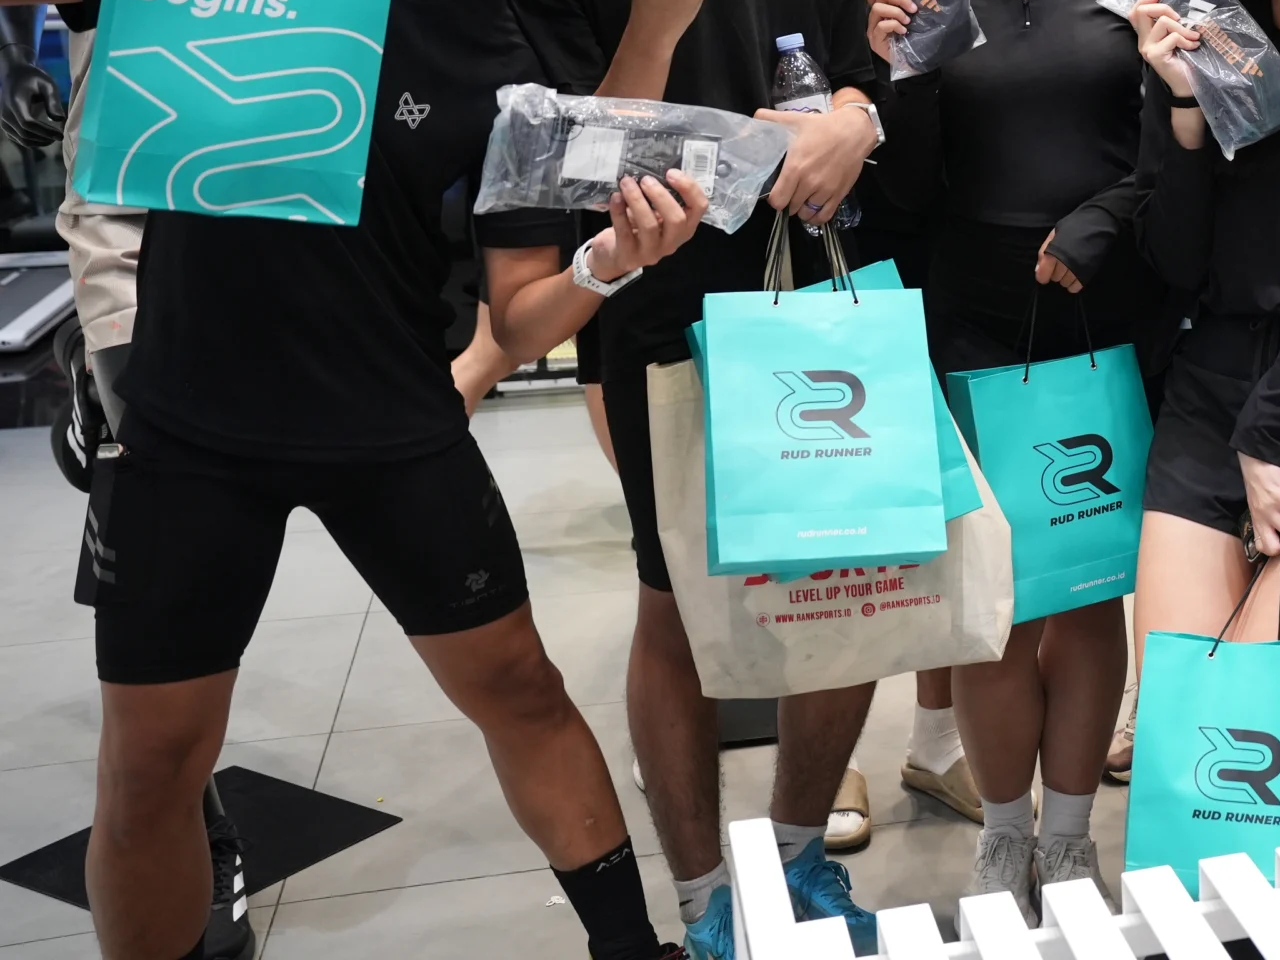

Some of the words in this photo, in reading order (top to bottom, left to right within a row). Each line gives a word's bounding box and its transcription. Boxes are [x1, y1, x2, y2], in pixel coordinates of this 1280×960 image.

[780, 448, 811, 461] RUD
[814, 446, 873, 459] RUNNER
[1049, 513, 1075, 527] RUD
[1077, 500, 1123, 521] RUNNER
[796, 526, 868, 540] rudrunner.co.id
[788, 589, 823, 604] LEVEL
[826, 586, 841, 601] UP
[844, 582, 873, 599] YOUR
[875, 576, 905, 595] GAME
[1069, 571, 1126, 593] rudrunner.co.id
[775, 608, 852, 624] WWW.RANKSPORTS.ID
[1191, 809, 1222, 822] RUD
